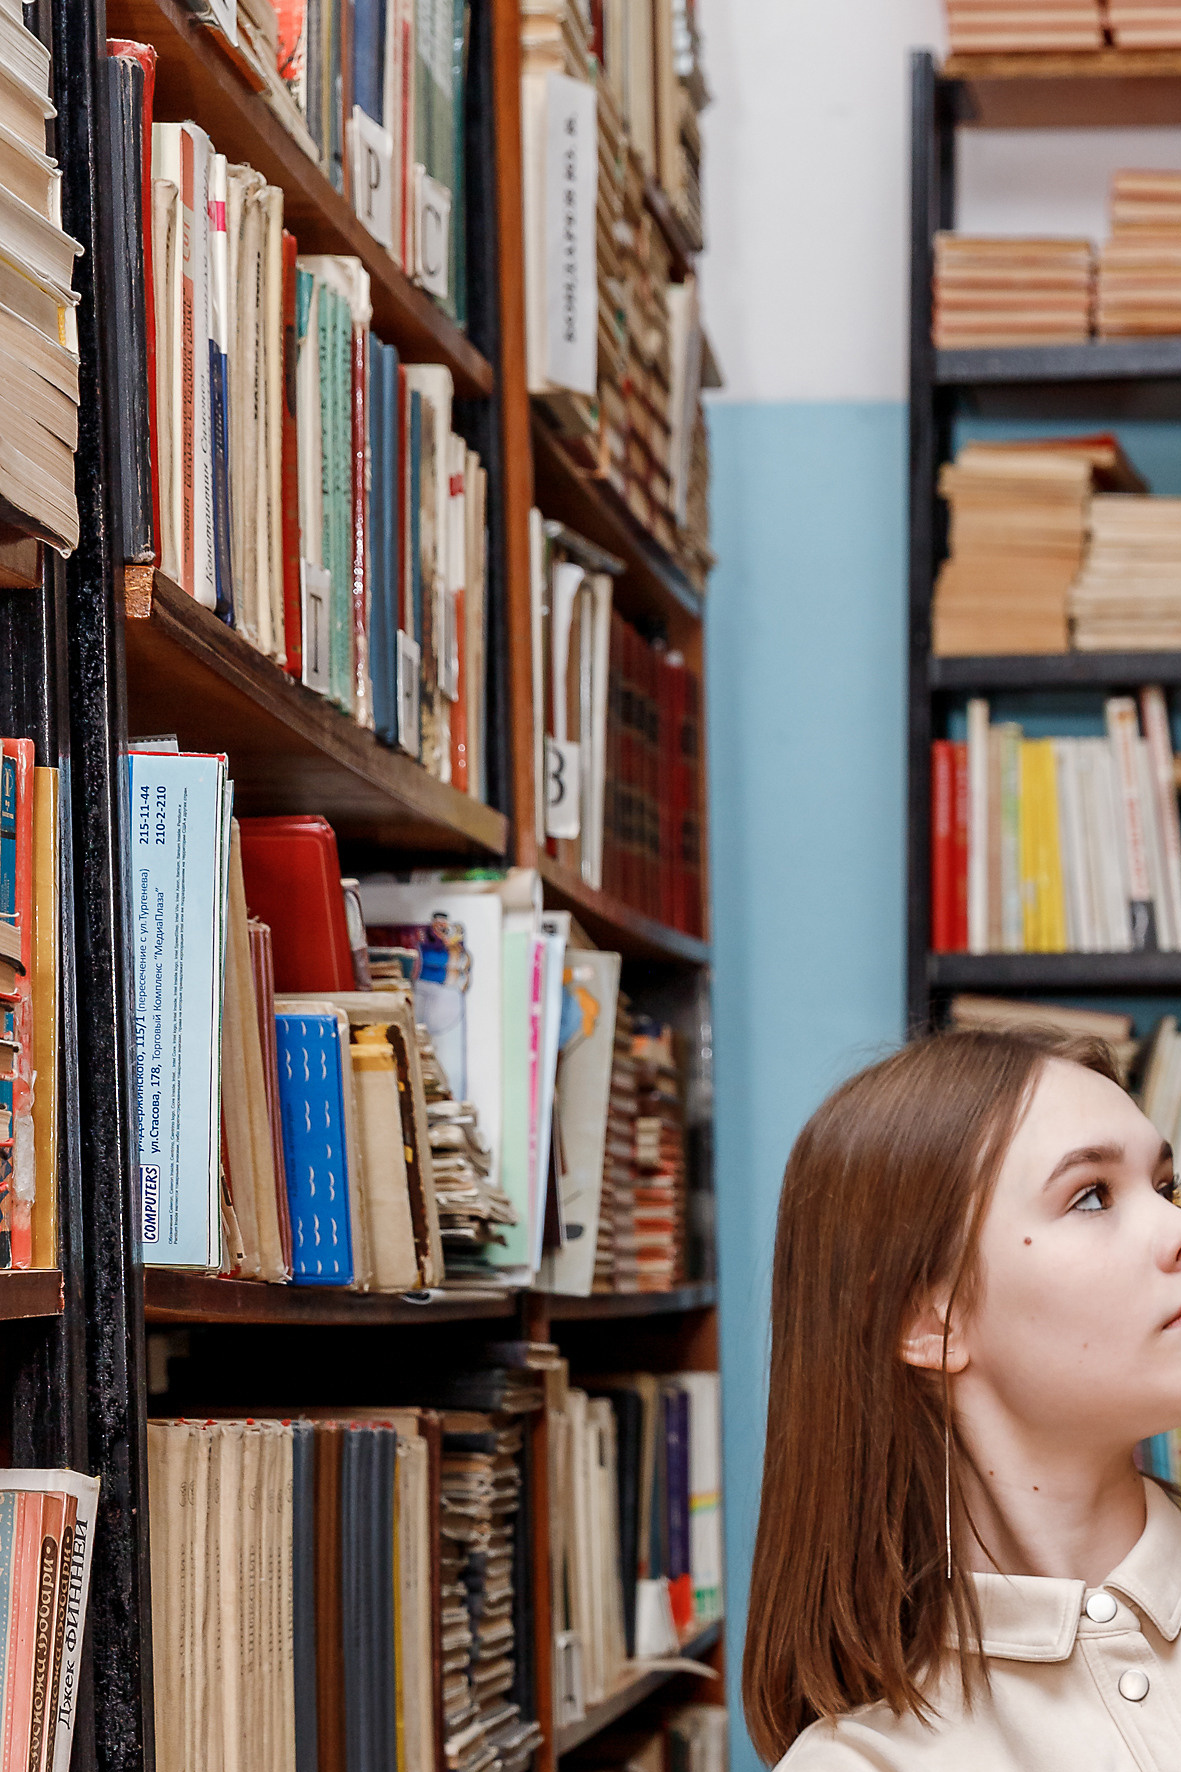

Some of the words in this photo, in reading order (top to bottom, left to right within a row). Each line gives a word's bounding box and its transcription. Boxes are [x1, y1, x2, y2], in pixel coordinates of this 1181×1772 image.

[203, 462, 213, 585] Константин
[139, 785, 150, 845] 215-11-44
[155, 785, 166, 845] 210-2-210
[139, 868, 149, 934] ул.Тургенева)
[138, 944, 148, 1013] (пересечение
[153, 963, 163, 1011] Комплекс
[136, 1015, 147, 1048] 115/1
[152, 1014, 162, 1060] Торговый
[151, 1064, 161, 1087] 178,
[150, 1090, 161, 1154] ул.Стасова,
[143, 1166, 157, 1241] COMPUTERS
[37, 1557, 54, 1656] Бовари
[64, 1519, 88, 1652] ФИННЕЙ
[30, 1658, 46, 1764] Госпожа
[58, 1660, 76, 1730] Джек
